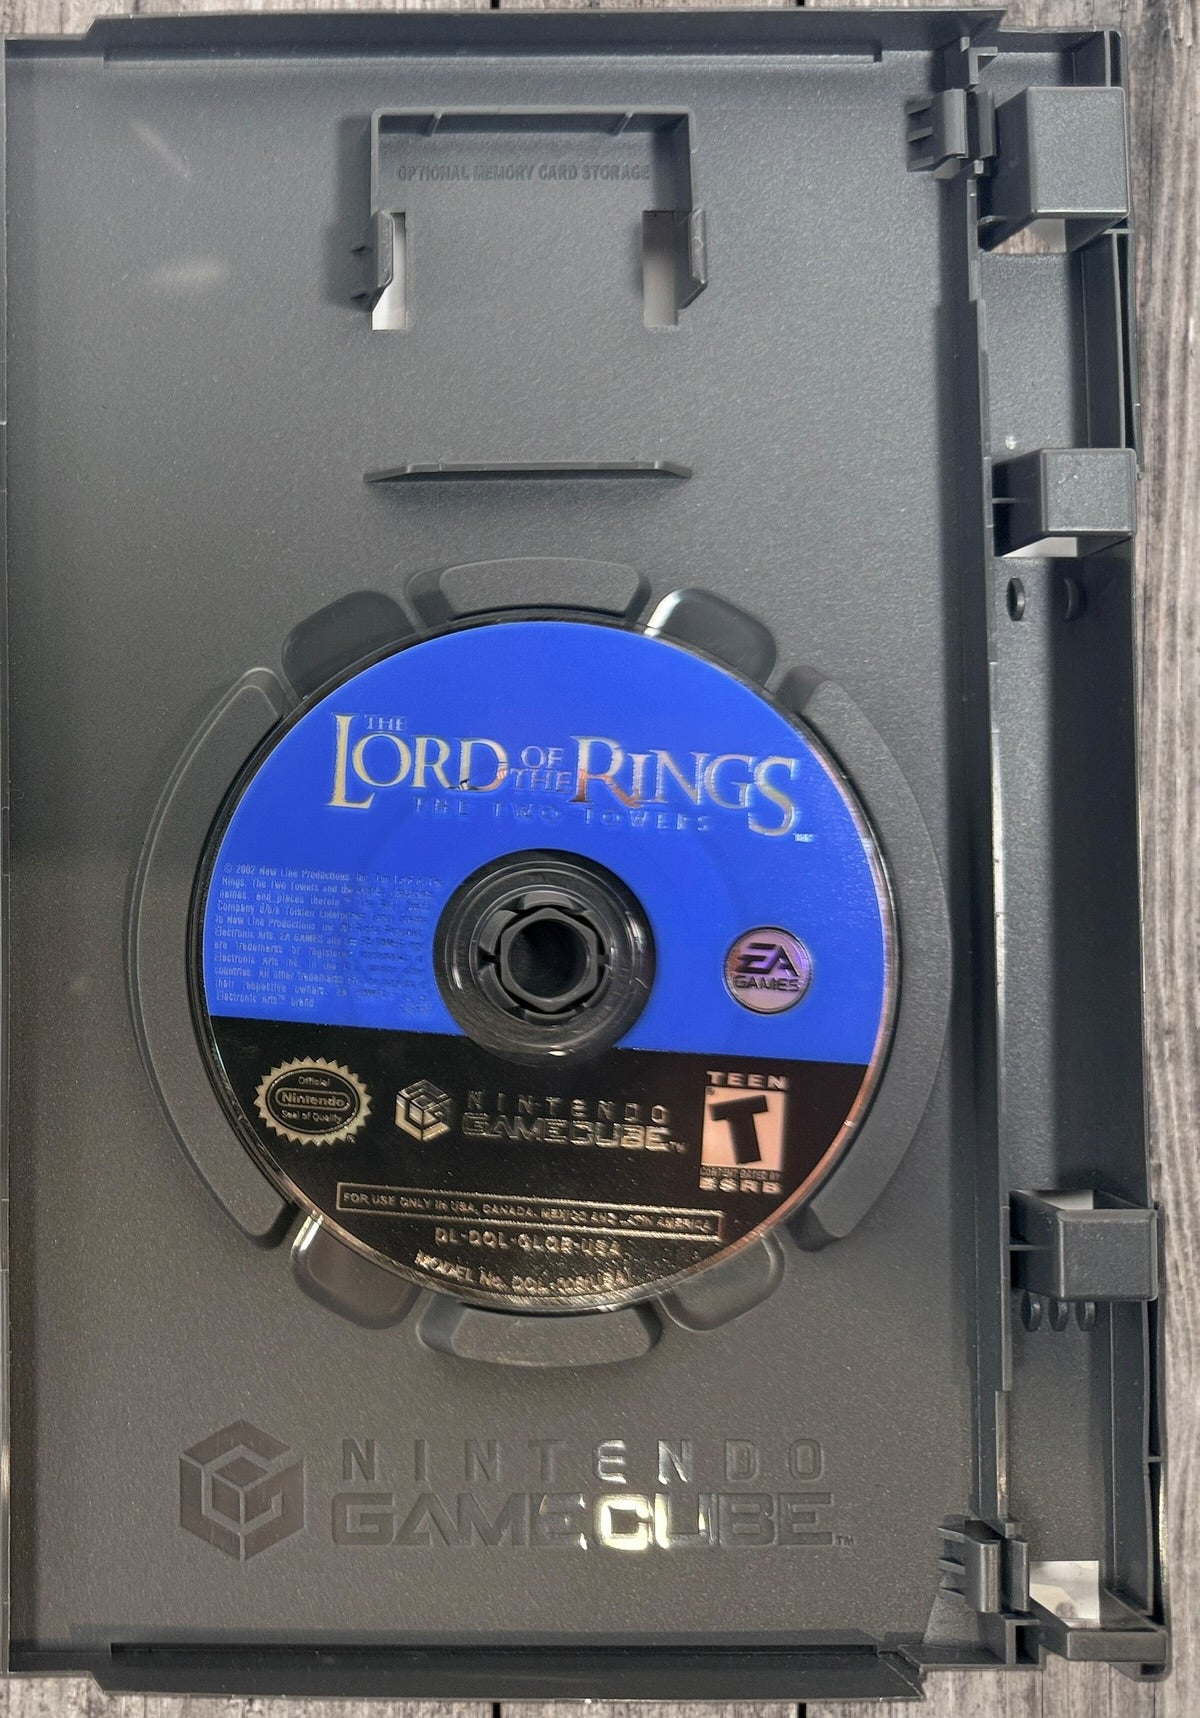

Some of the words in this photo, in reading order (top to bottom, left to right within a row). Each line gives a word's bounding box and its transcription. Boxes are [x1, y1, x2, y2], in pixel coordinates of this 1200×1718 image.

[399, 164, 469, 181] OPTIONAL
[473, 164, 534, 181] MEMORY
[538, 164, 578, 181] CARD
[582, 164, 650, 181] STORAGE
[365, 714, 406, 732] THE
[328, 712, 508, 809] LORD
[520, 745, 564, 770] OF
[509, 766, 570, 793] THE
[569, 734, 798, 837] RINGS
[414, 796, 469, 817] THE
[494, 801, 559, 824] TWO
[583, 806, 711, 832] TOWERS
[735, 942, 800, 977] EA
[733, 974, 800, 992] GAMES
[706, 1070, 788, 1090] TEEN
[281, 1090, 346, 1107] Nintendo
[468, 1089, 668, 1125] NINTENDO
[462, 1111, 670, 1153] GAMECUBE
[709, 1094, 768, 1165] T
[343, 1192, 369, 1205] FOR
[372, 1194, 396, 1206] USE
[399, 1196, 432, 1210] ONLY
[341, 1438, 828, 1486] NINTENDO
[331, 1490, 834, 1550] GAMECUBE
